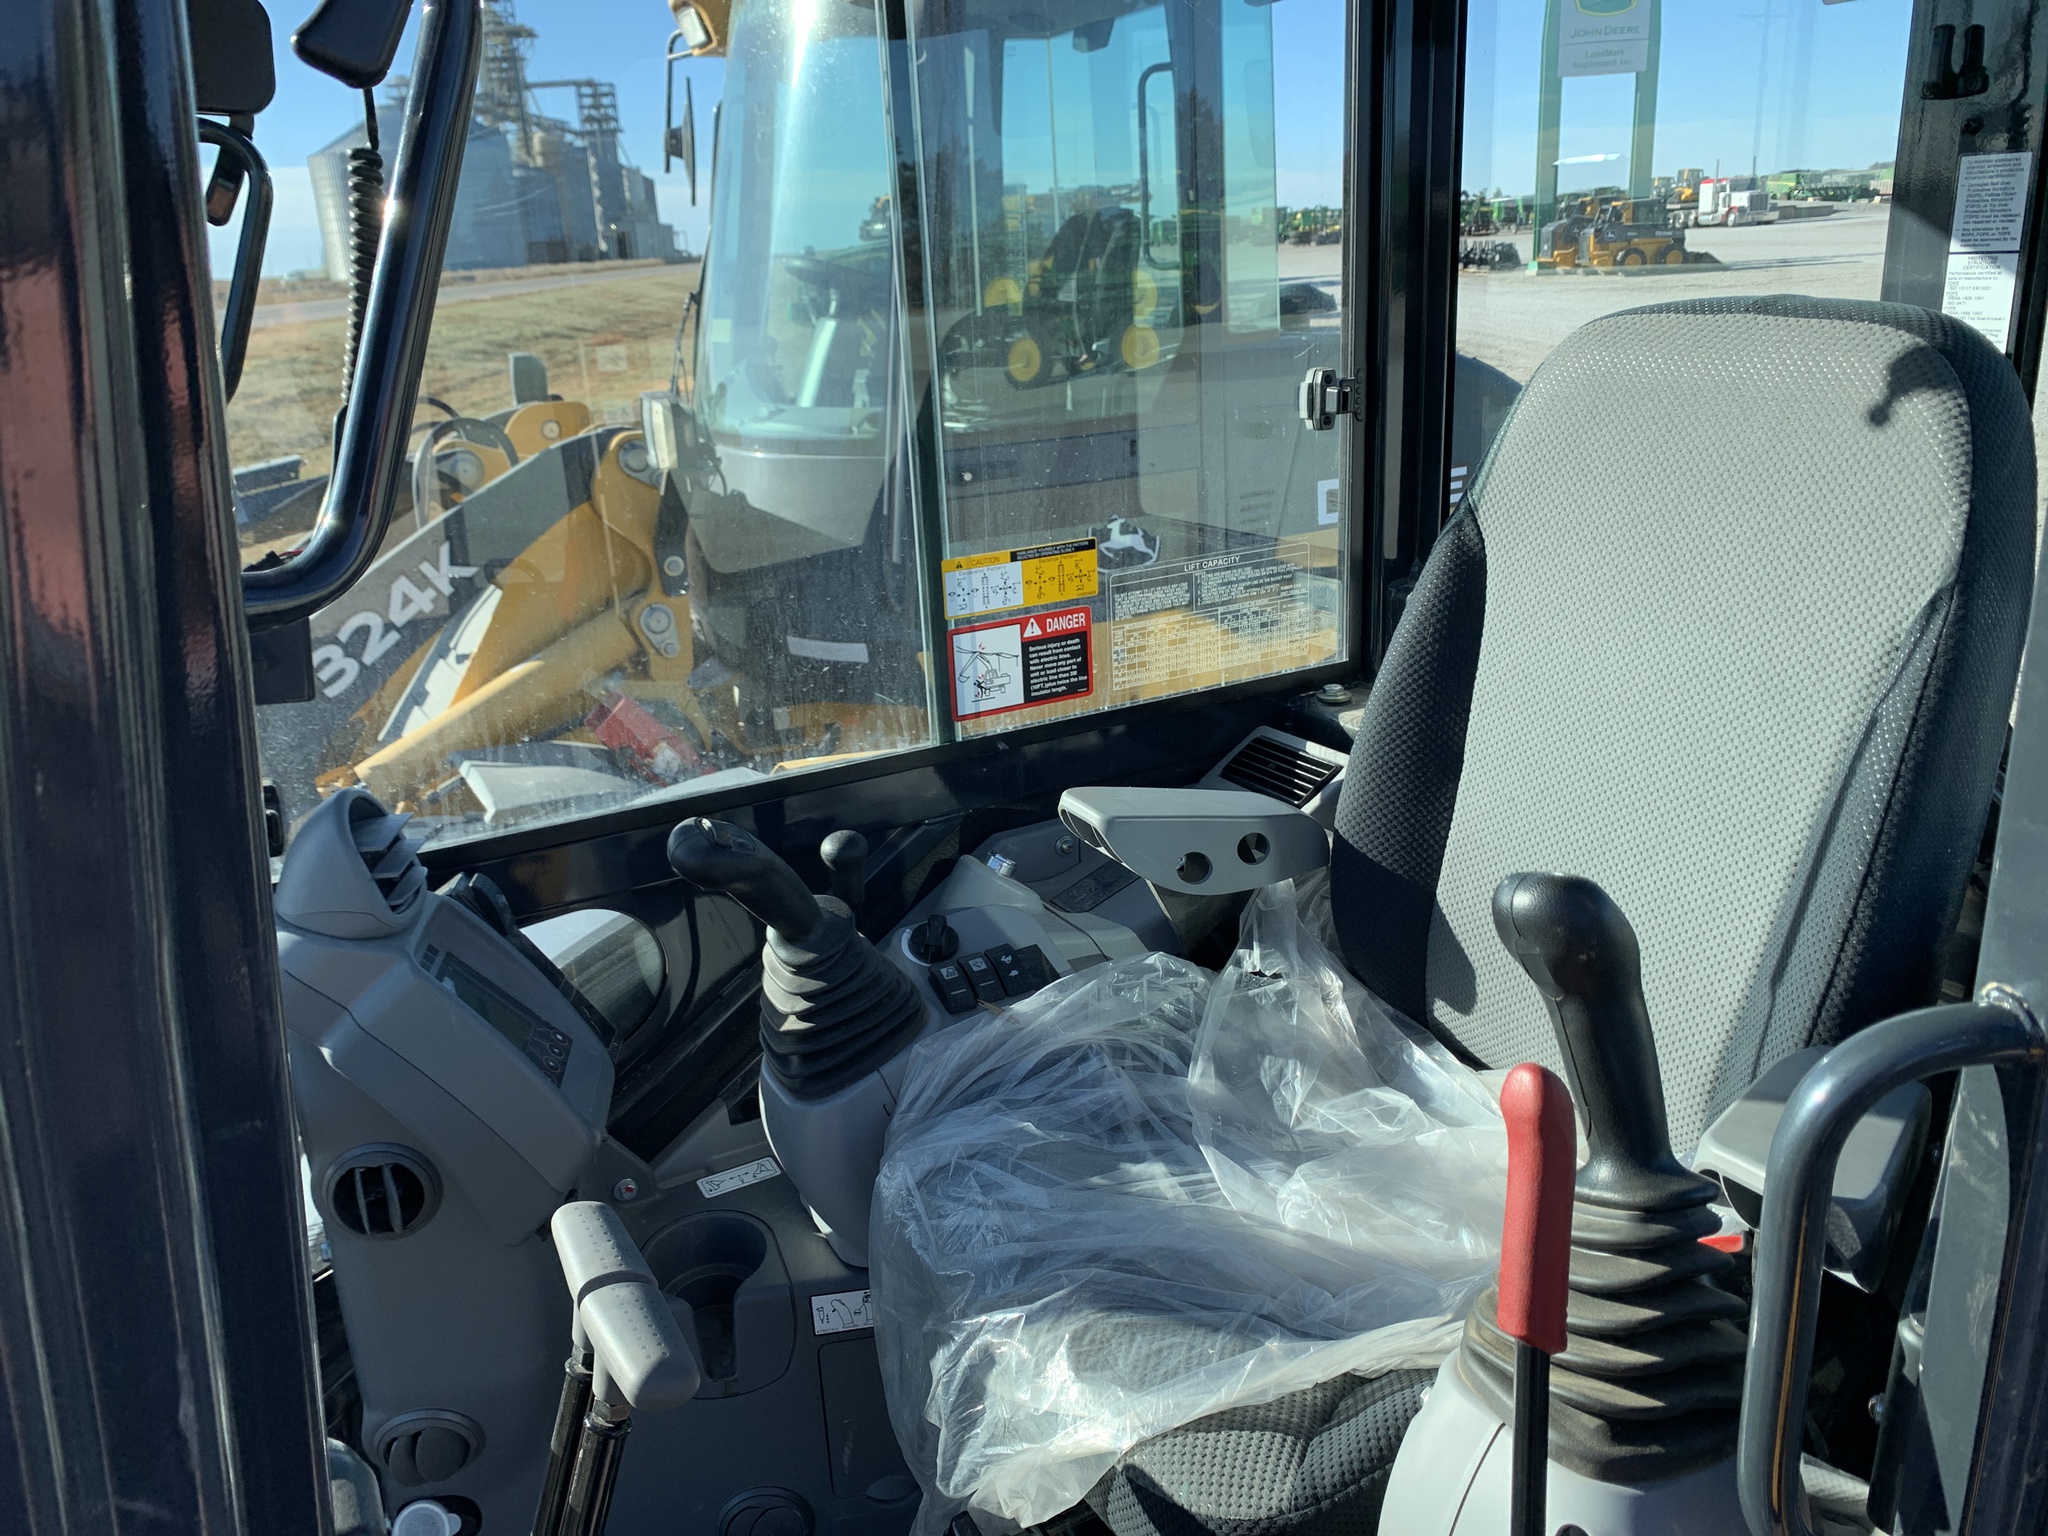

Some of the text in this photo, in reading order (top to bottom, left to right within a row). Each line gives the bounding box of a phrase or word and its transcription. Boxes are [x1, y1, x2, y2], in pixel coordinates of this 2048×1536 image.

[1570, 25, 1640, 38] JOHN DEERE
[971, 556, 1000, 566] CAUTION
[1184, 562, 1200, 572] LIFT
[1202, 556, 1240, 569] CAPACITY
[312, 540, 479, 699] 324K
[1046, 613, 1086, 632] DANGER
